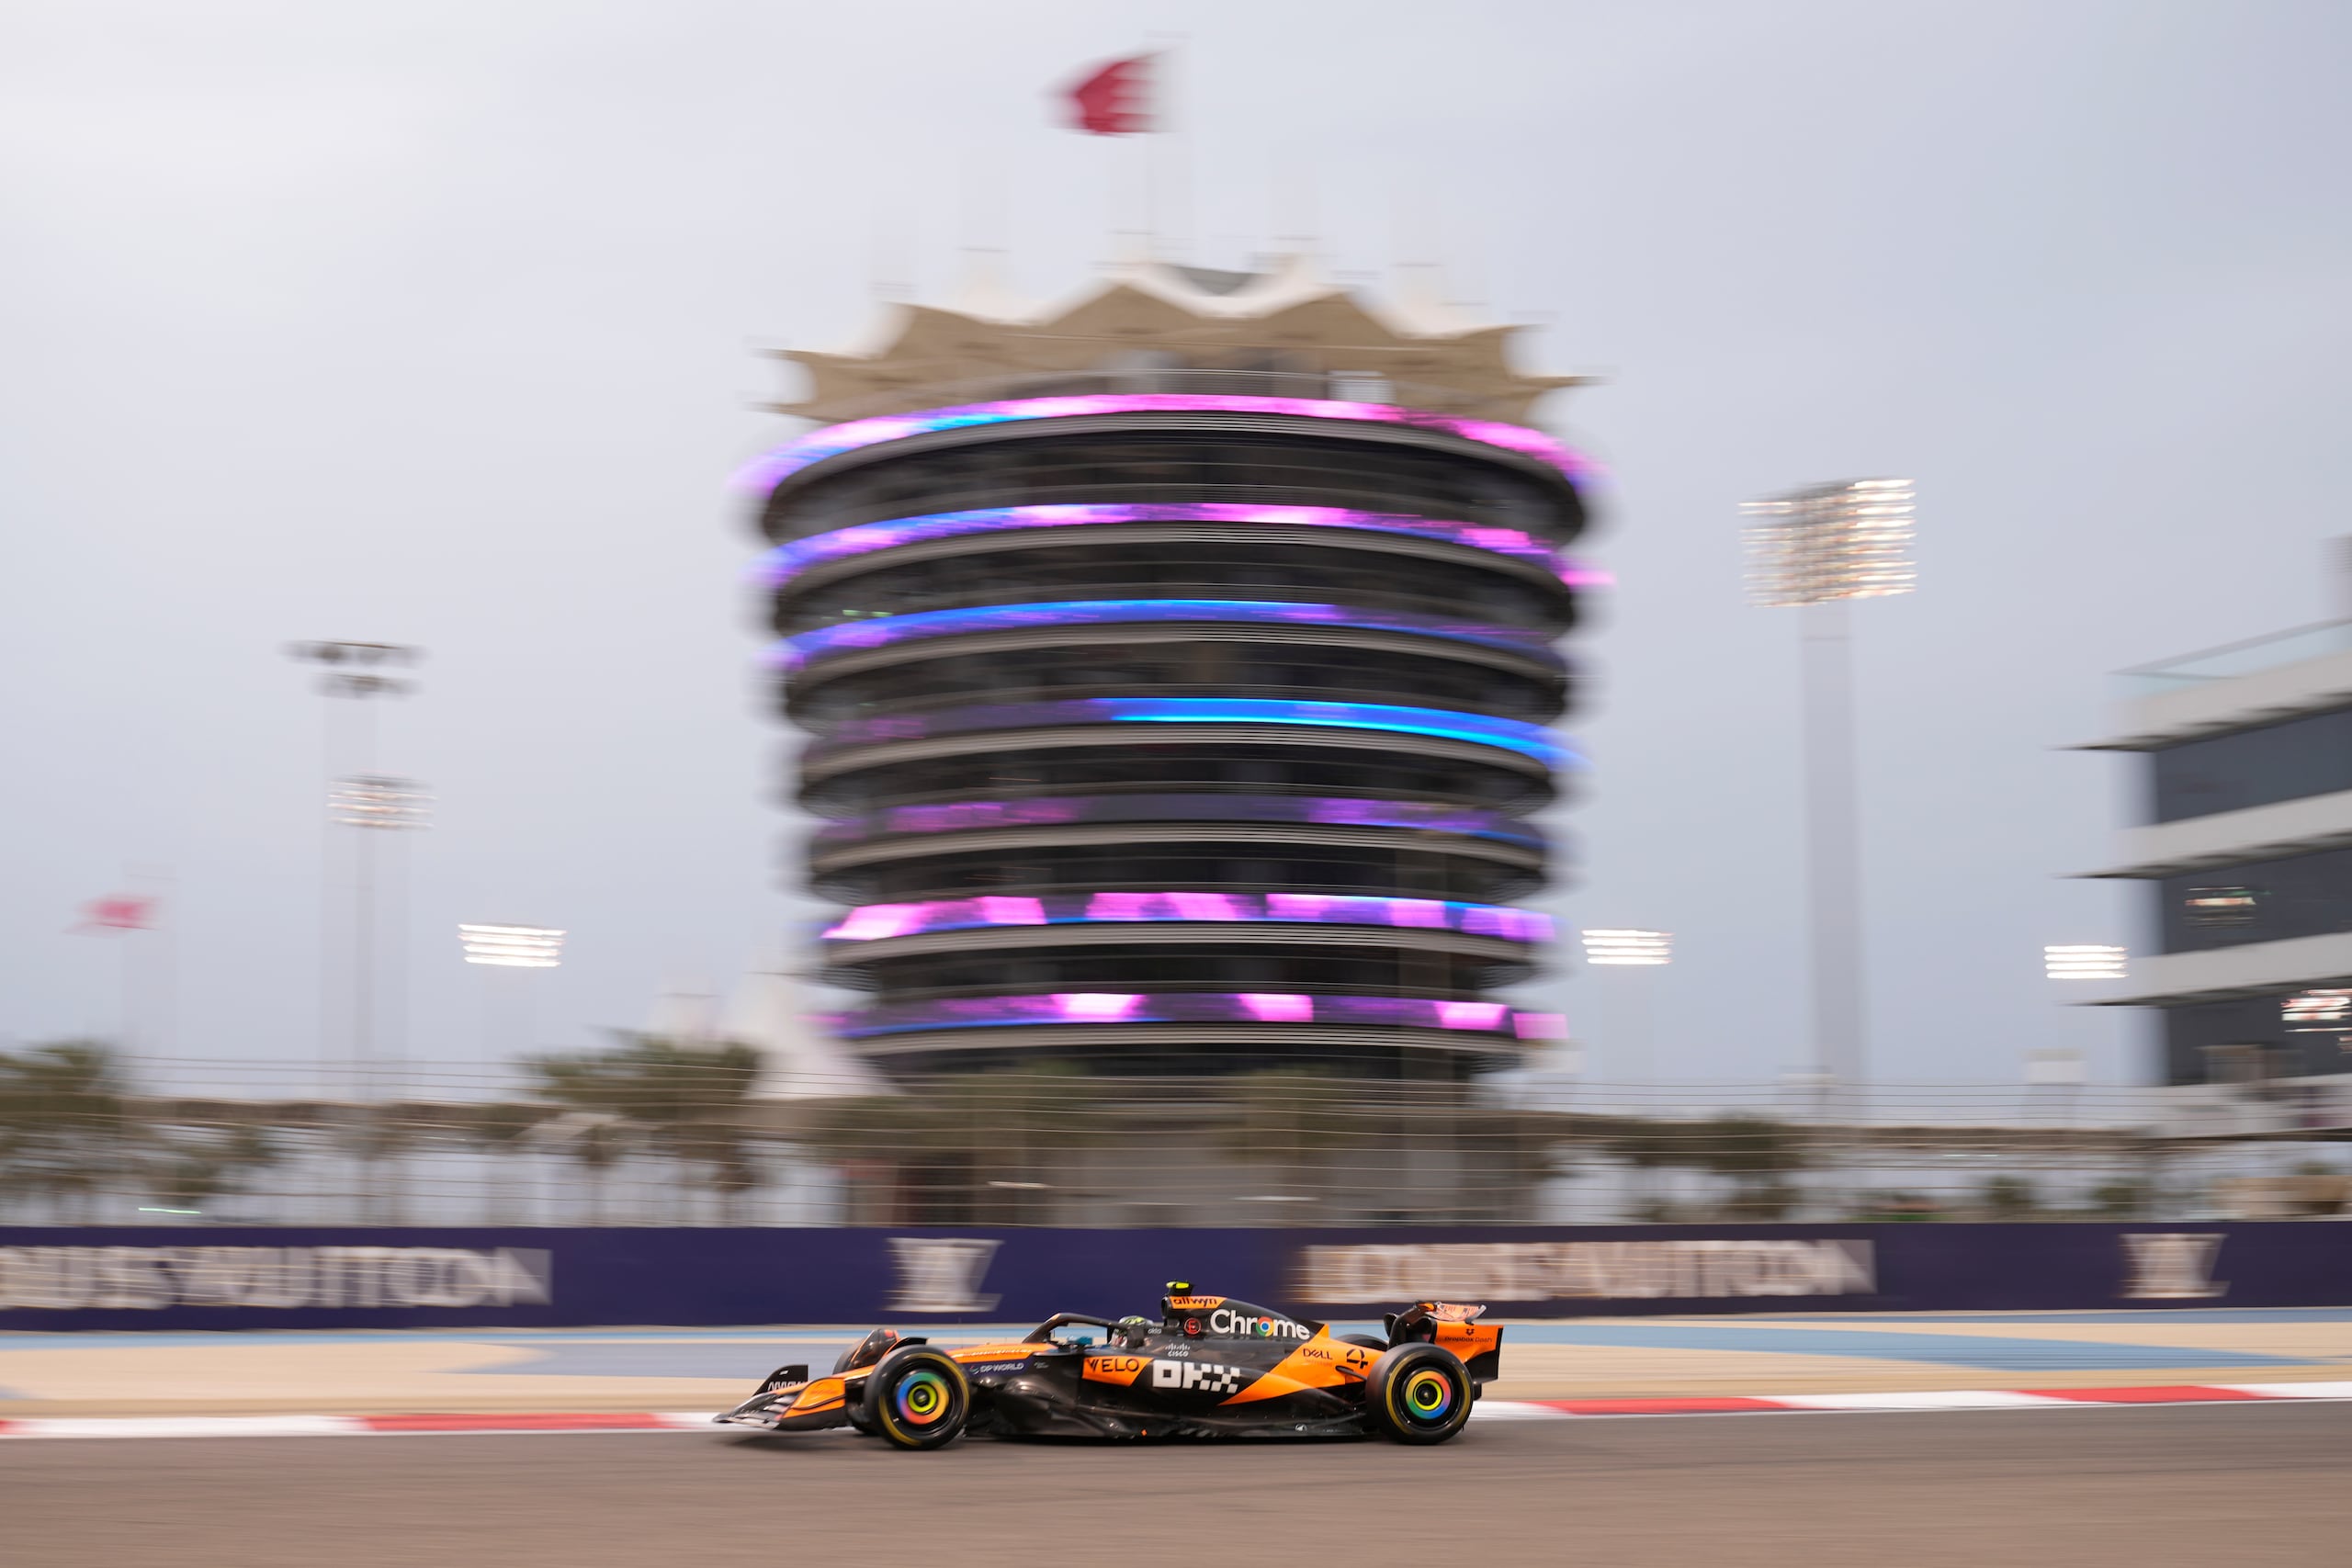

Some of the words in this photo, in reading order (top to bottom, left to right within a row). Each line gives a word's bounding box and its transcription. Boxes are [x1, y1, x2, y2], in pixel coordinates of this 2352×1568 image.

[1172, 1296, 1218, 1307] allwyn
[1210, 1309, 1311, 1339] Chrome
[1303, 1348, 1333, 1360] DELL
[1086, 1358, 1139, 1372] VELO
[1152, 1359, 1240, 1394] OKX
